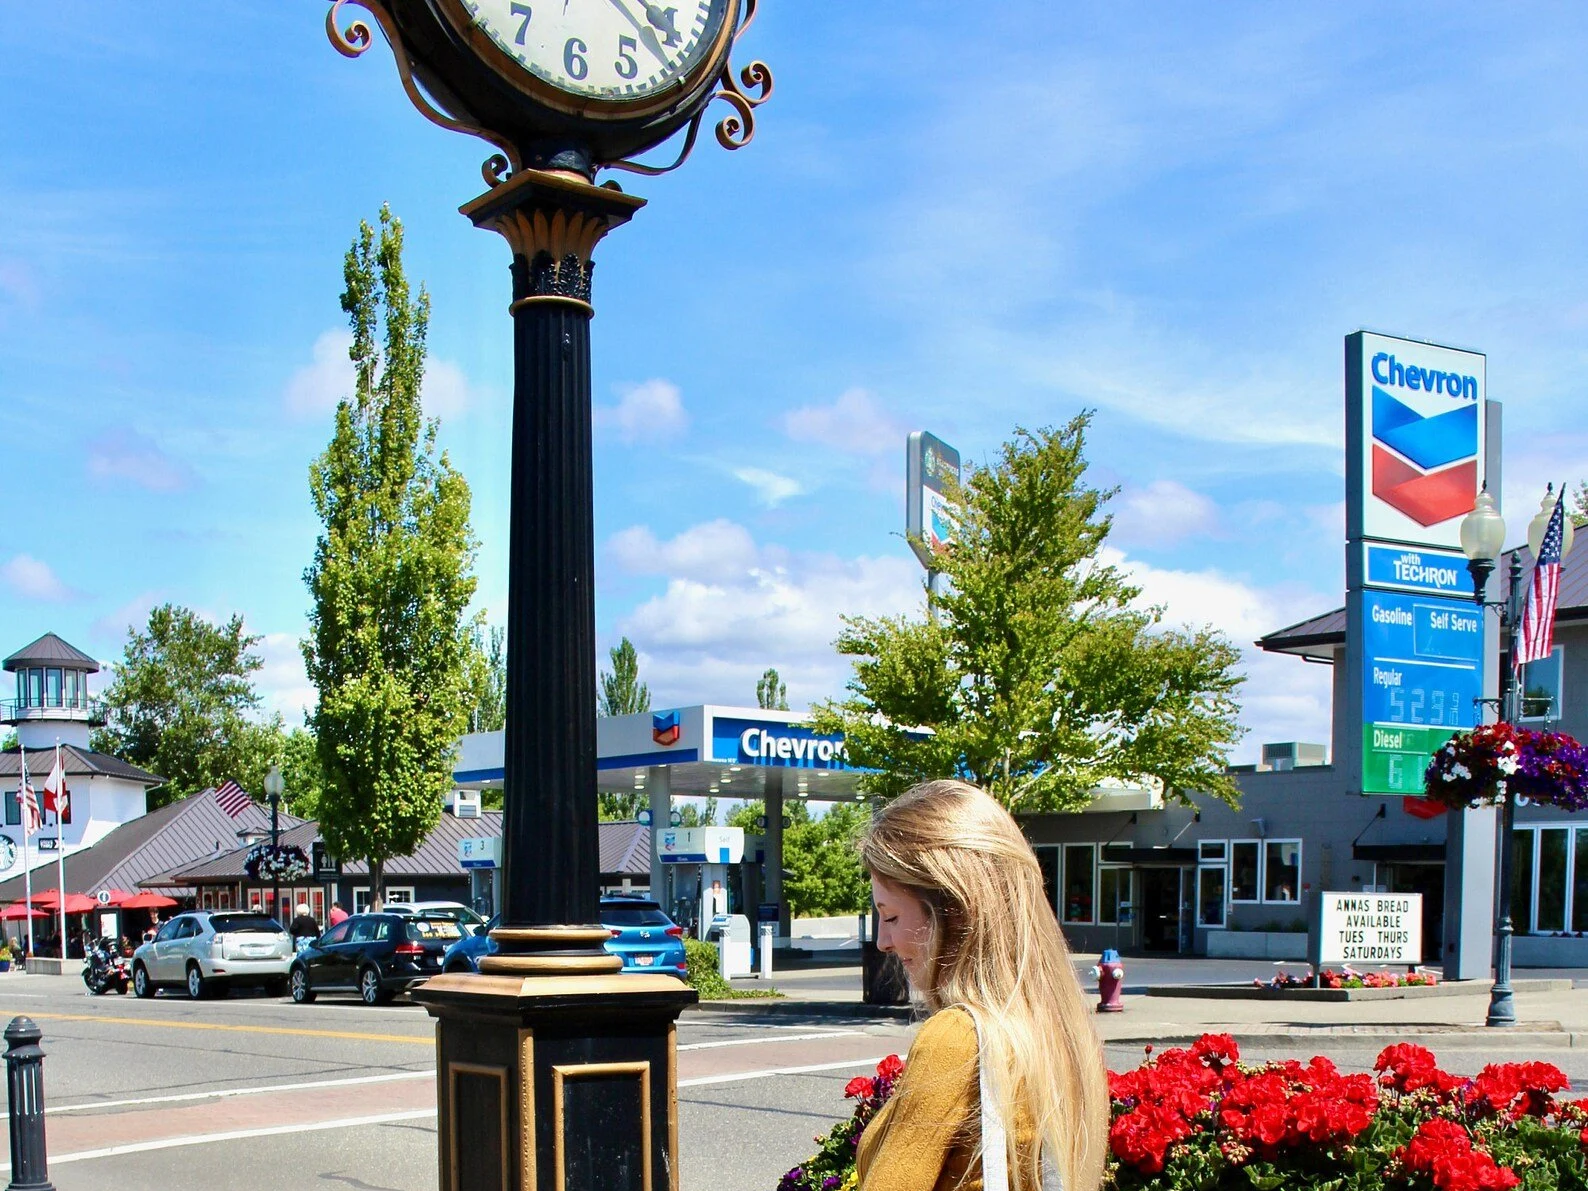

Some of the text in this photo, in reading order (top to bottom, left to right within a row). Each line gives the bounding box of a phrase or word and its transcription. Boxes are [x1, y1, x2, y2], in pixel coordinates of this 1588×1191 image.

[510, 2, 532, 45] 7
[563, 37, 588, 81] 6
[614, 34, 638, 80] 5
[1371, 352, 1477, 400] Chevron
[1400, 553, 1421, 566] with
[1393, 560, 1457, 588] TECHRON
[1372, 604, 1413, 626] Gasoline
[1430, 611, 1477, 633] Self Serve
[1373, 667, 1403, 688] Regular
[1373, 730, 1402, 749] Diesel
[1336, 899, 1409, 913] ANNAS BREAD
[1346, 915, 1401, 928] AVAILABLE
[1339, 930, 1409, 943] TUES THURS
[1343, 946, 1402, 959] SATURDAYS
